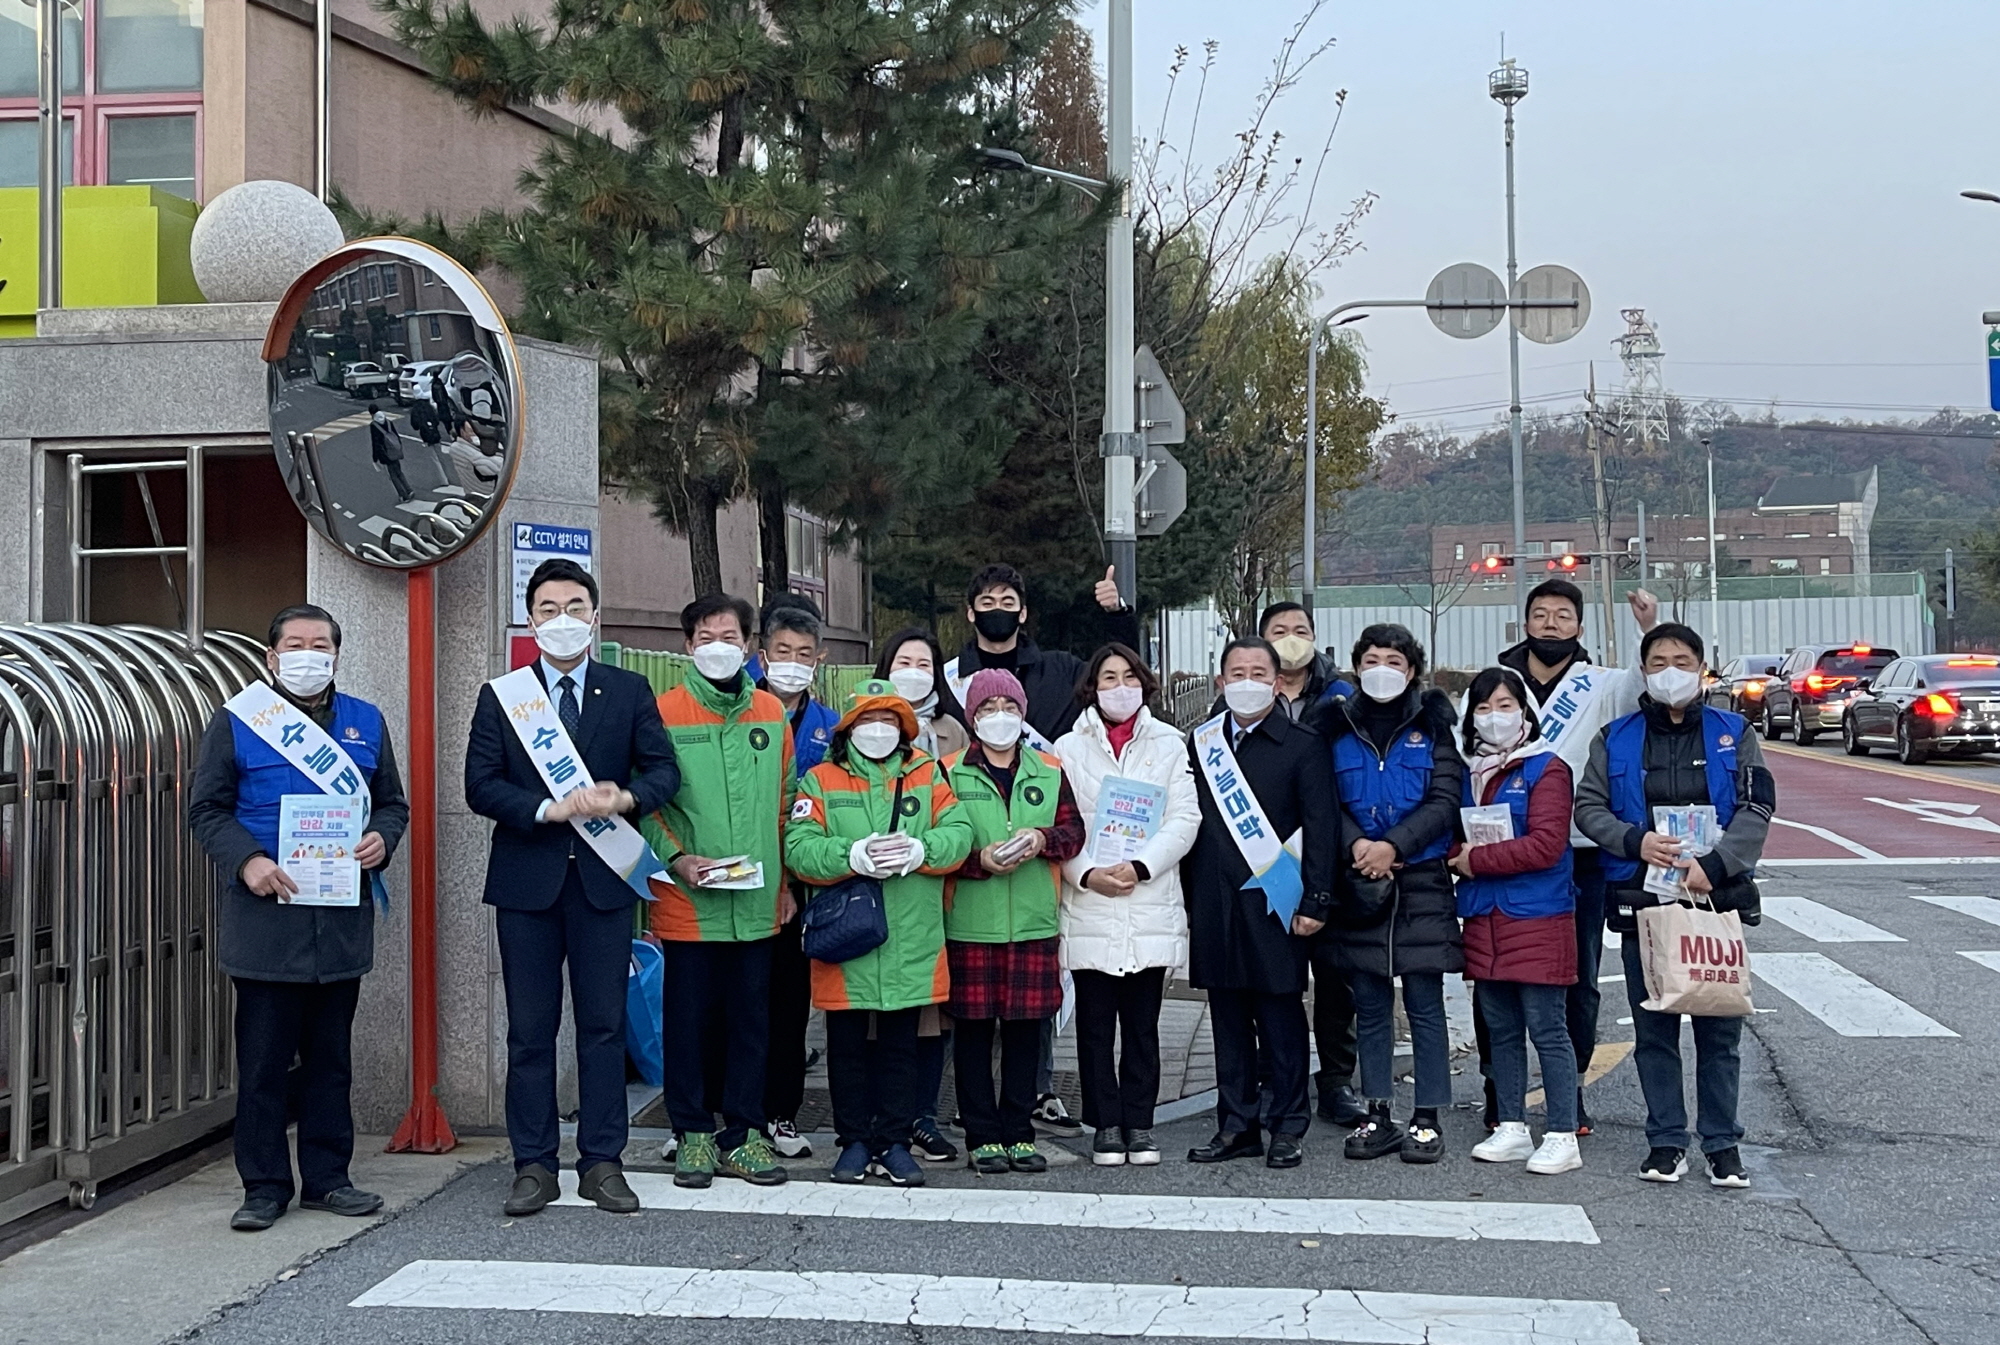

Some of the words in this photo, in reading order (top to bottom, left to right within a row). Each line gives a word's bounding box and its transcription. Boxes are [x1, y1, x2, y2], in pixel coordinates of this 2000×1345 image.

[534, 531, 556, 546] CCTV
[557, 532, 573, 549] 설치
[573, 534, 589, 550] 안내
[1206, 746, 1265, 840] 수능대박
[299, 819, 323, 830] 반값
[1680, 935, 1745, 968] MUJI
[1689, 968, 1740, 984] 無印良品
